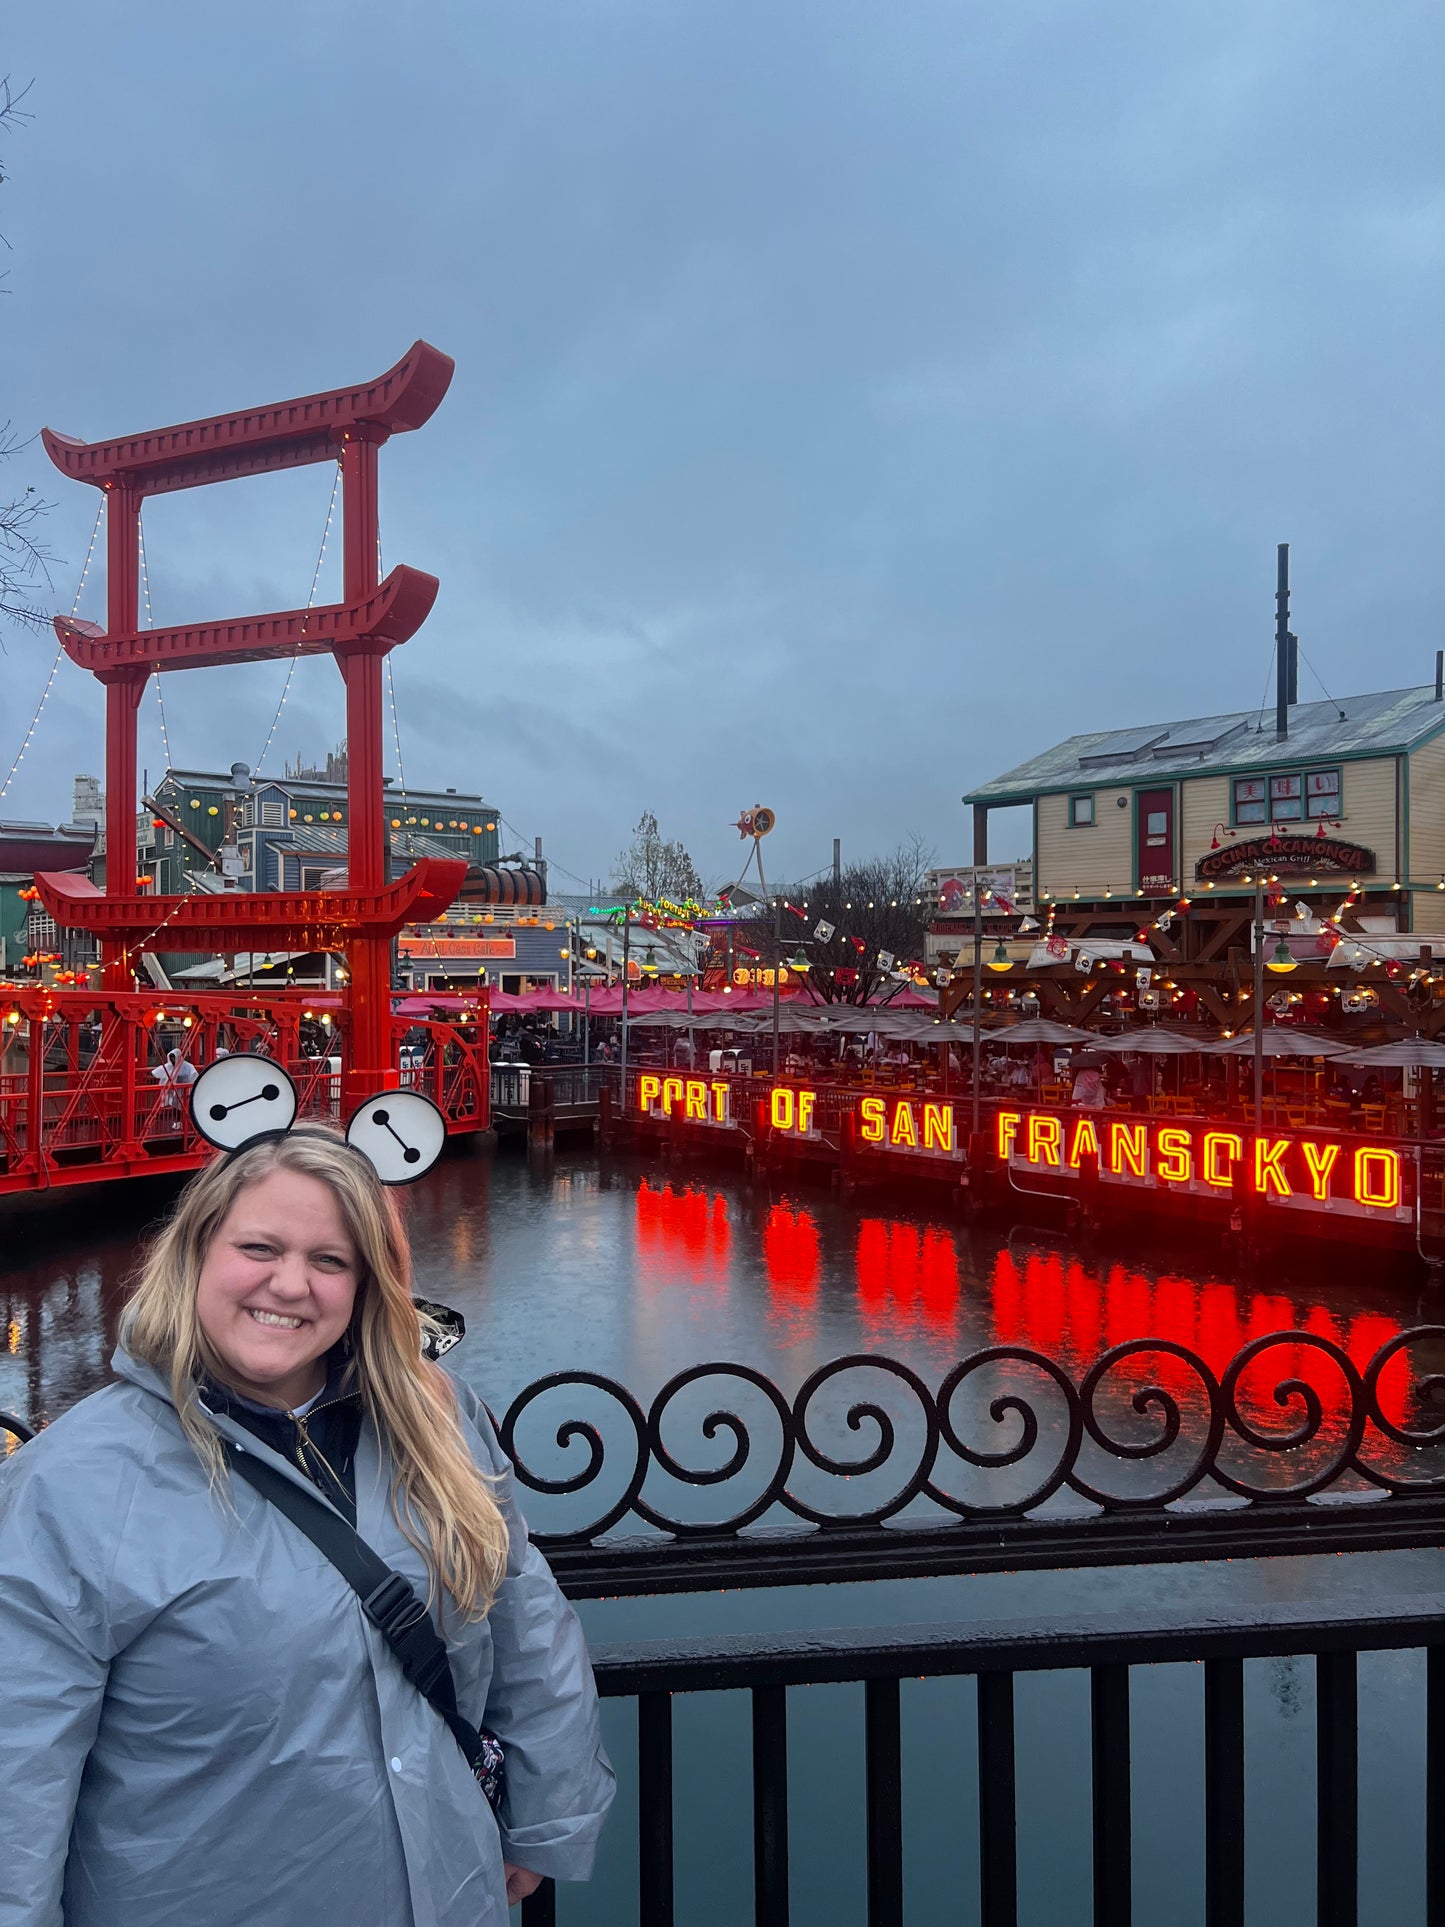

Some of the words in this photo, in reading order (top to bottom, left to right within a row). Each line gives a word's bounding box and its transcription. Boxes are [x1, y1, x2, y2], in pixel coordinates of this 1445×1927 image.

[1201, 844, 1260, 876] COCINA
[1261, 840, 1367, 871] CUCAMONGA
[1253, 856, 1287, 866] Mexican
[1290, 854, 1311, 864] Grill
[640, 1075, 729, 1123] PORT
[771, 1088, 816, 1132] OF
[861, 1097, 953, 1152] SAN
[998, 1112, 1400, 1208] FRANSOKYO
